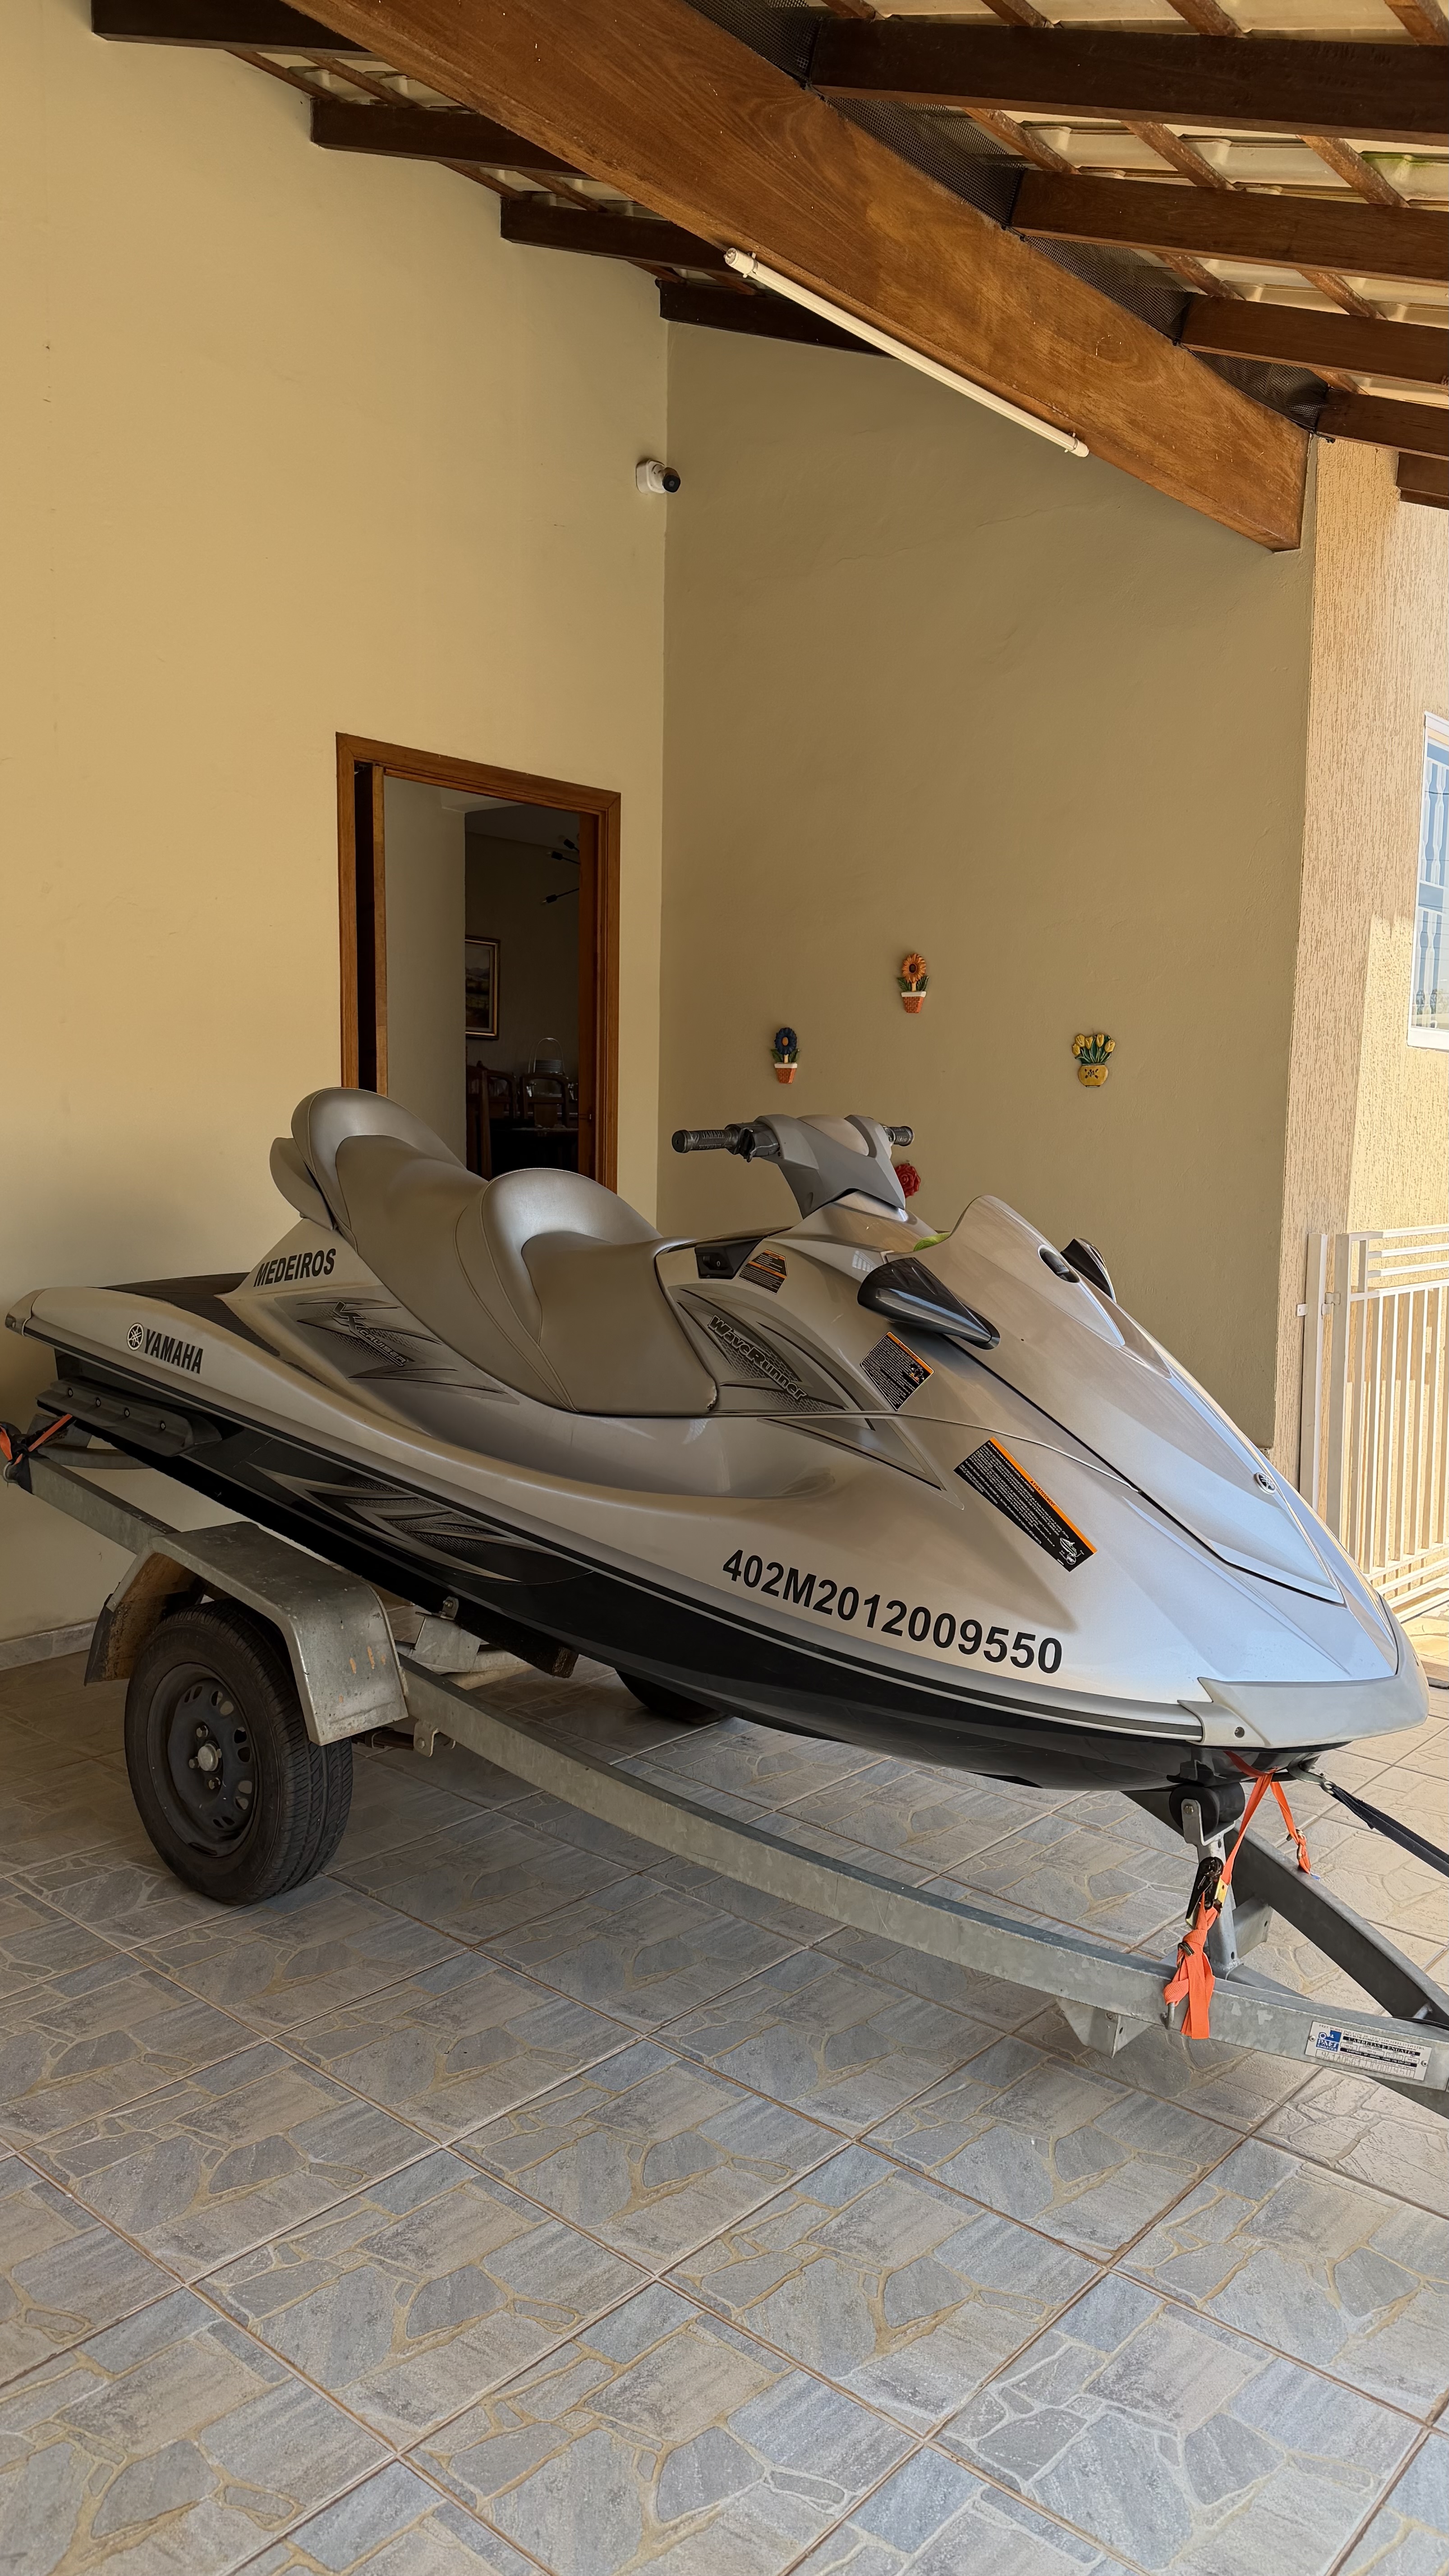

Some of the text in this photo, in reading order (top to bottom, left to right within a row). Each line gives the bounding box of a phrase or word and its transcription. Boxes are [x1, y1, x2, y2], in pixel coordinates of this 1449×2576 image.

[253, 1248, 336, 1287] MEDEIROS
[144, 1329, 203, 1374] YAMAHA
[359, 1329, 407, 1363] CRUISER
[722, 1550, 1062, 1674] 402M2012009550
